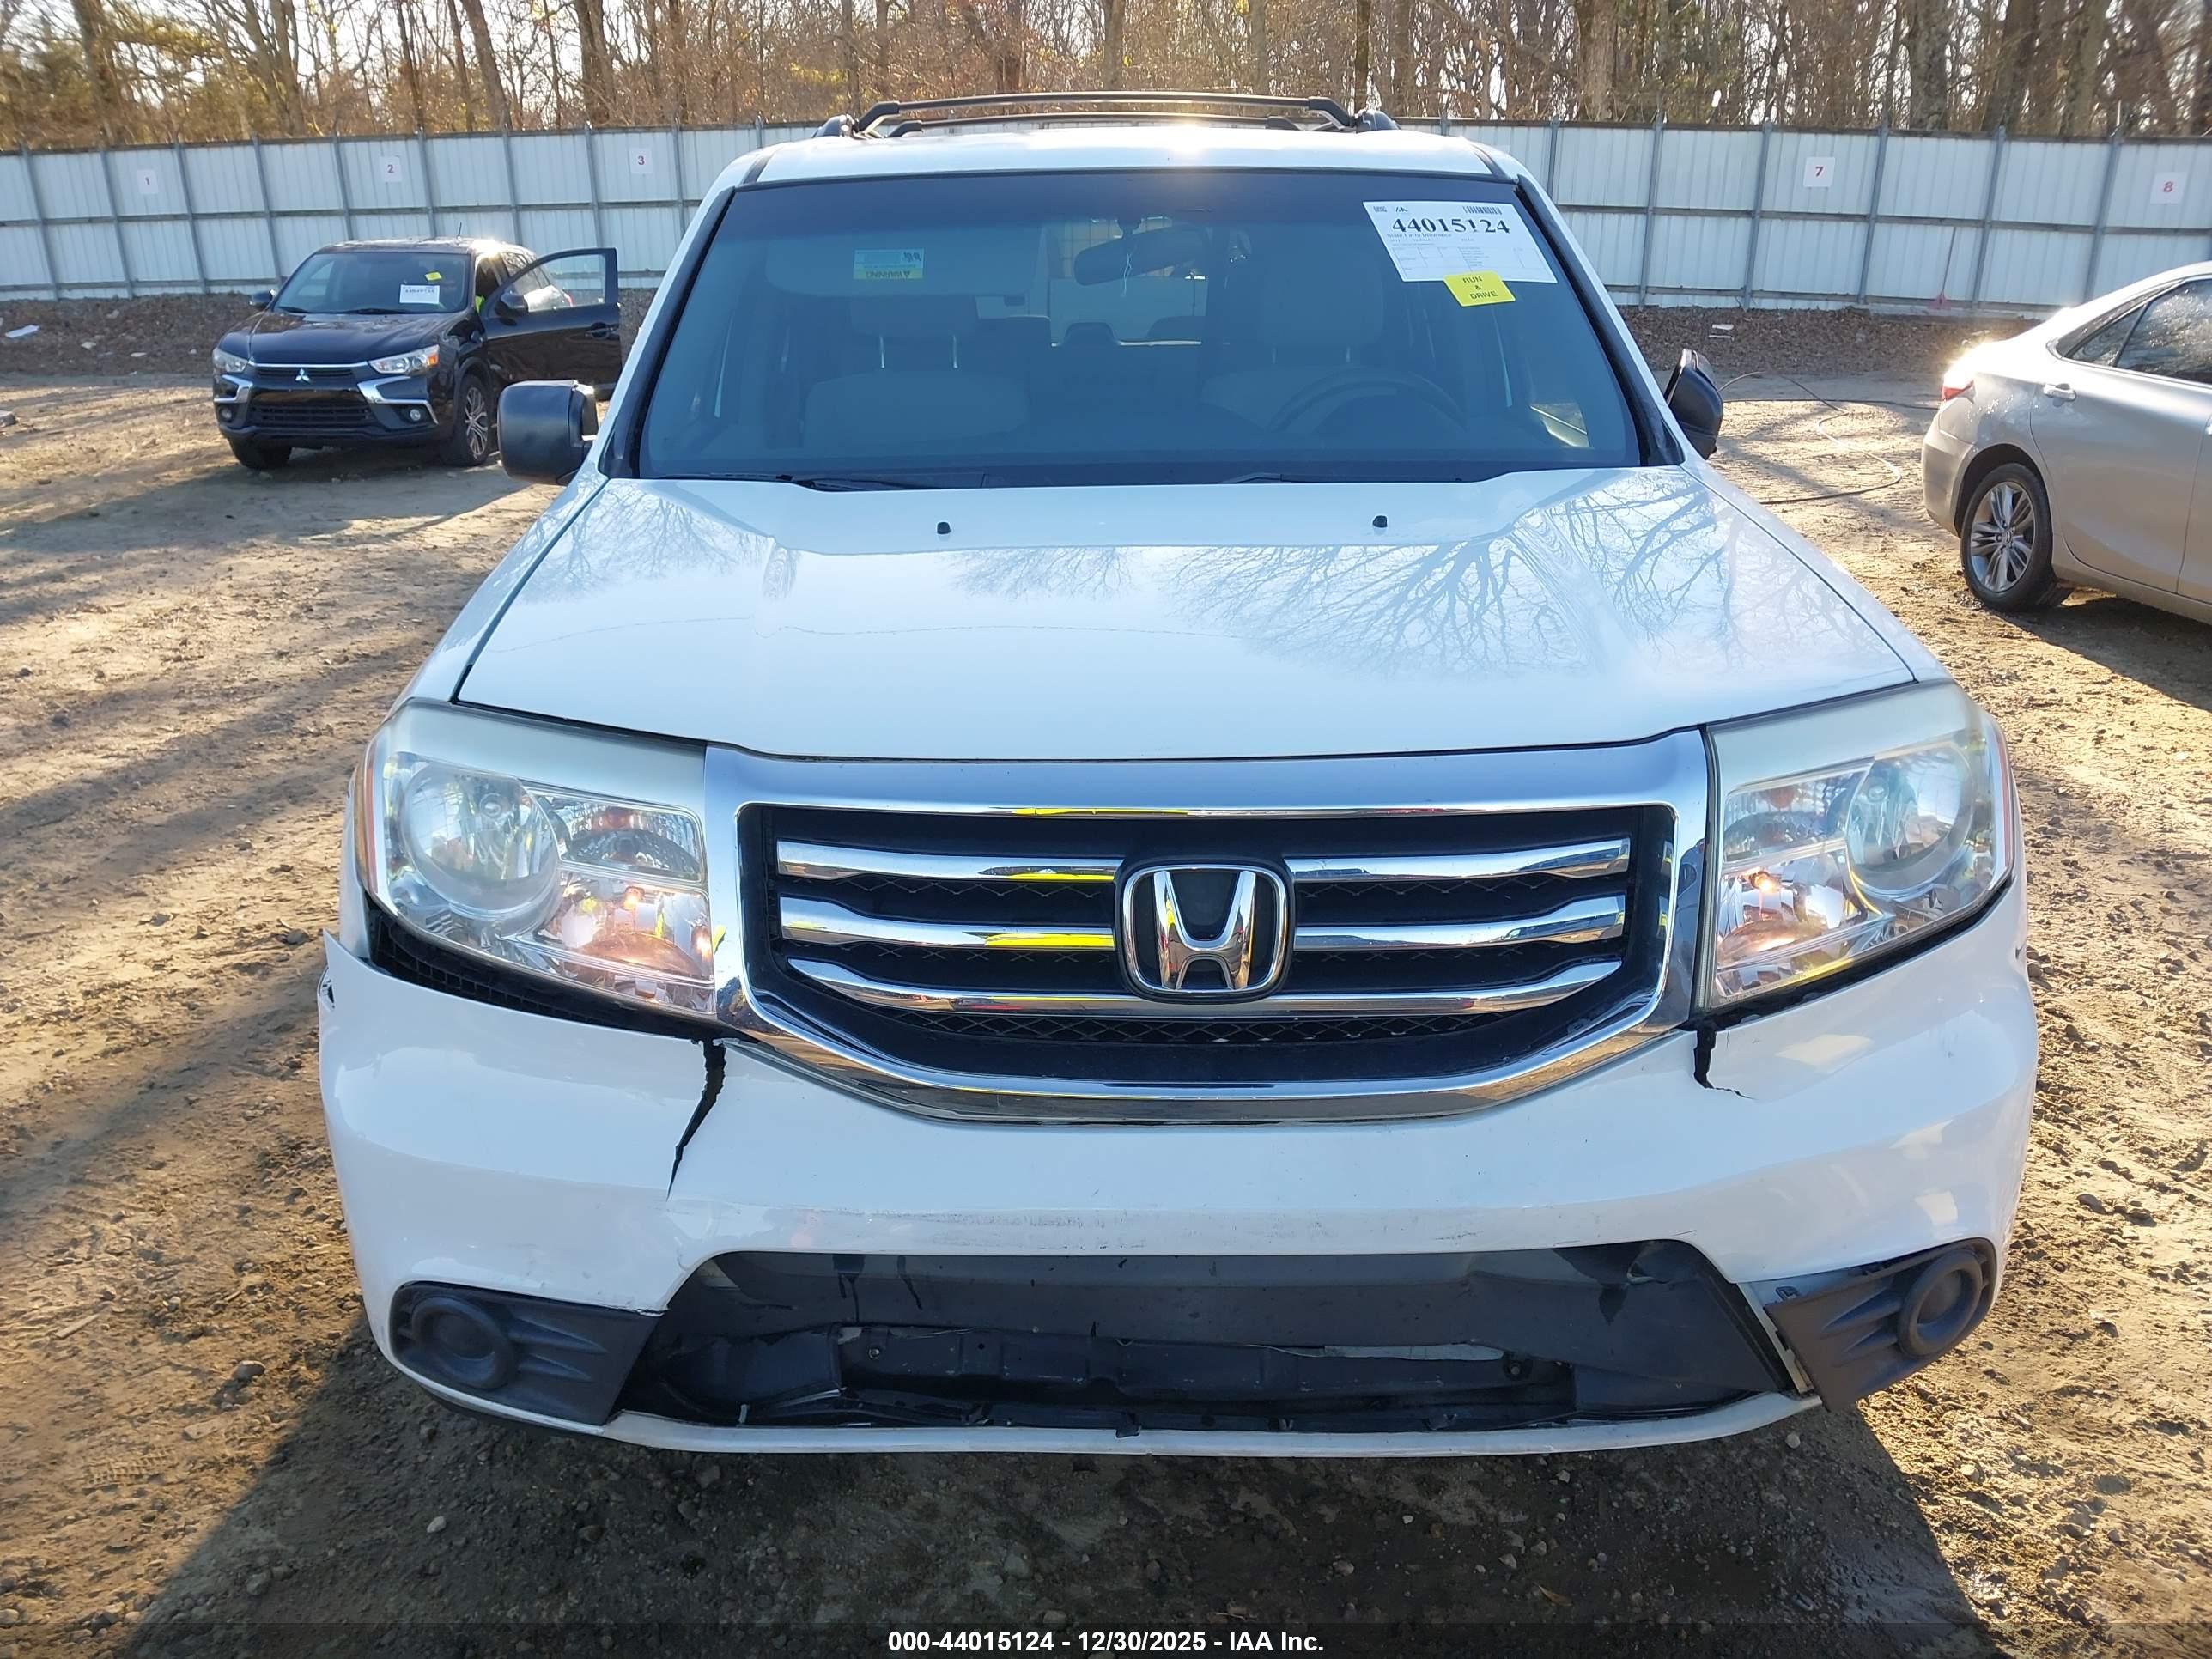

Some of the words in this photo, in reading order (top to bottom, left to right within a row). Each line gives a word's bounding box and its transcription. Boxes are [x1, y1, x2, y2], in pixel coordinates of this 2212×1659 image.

[638, 155, 645, 166] 3
[387, 164, 394, 173] 2
[1815, 166, 1824, 177] 7
[145, 177, 150, 186] 1
[2163, 181, 2173, 193] 8
[1392, 217, 1510, 234] 44015124
[1469, 290, 1498, 300] DRIVE
